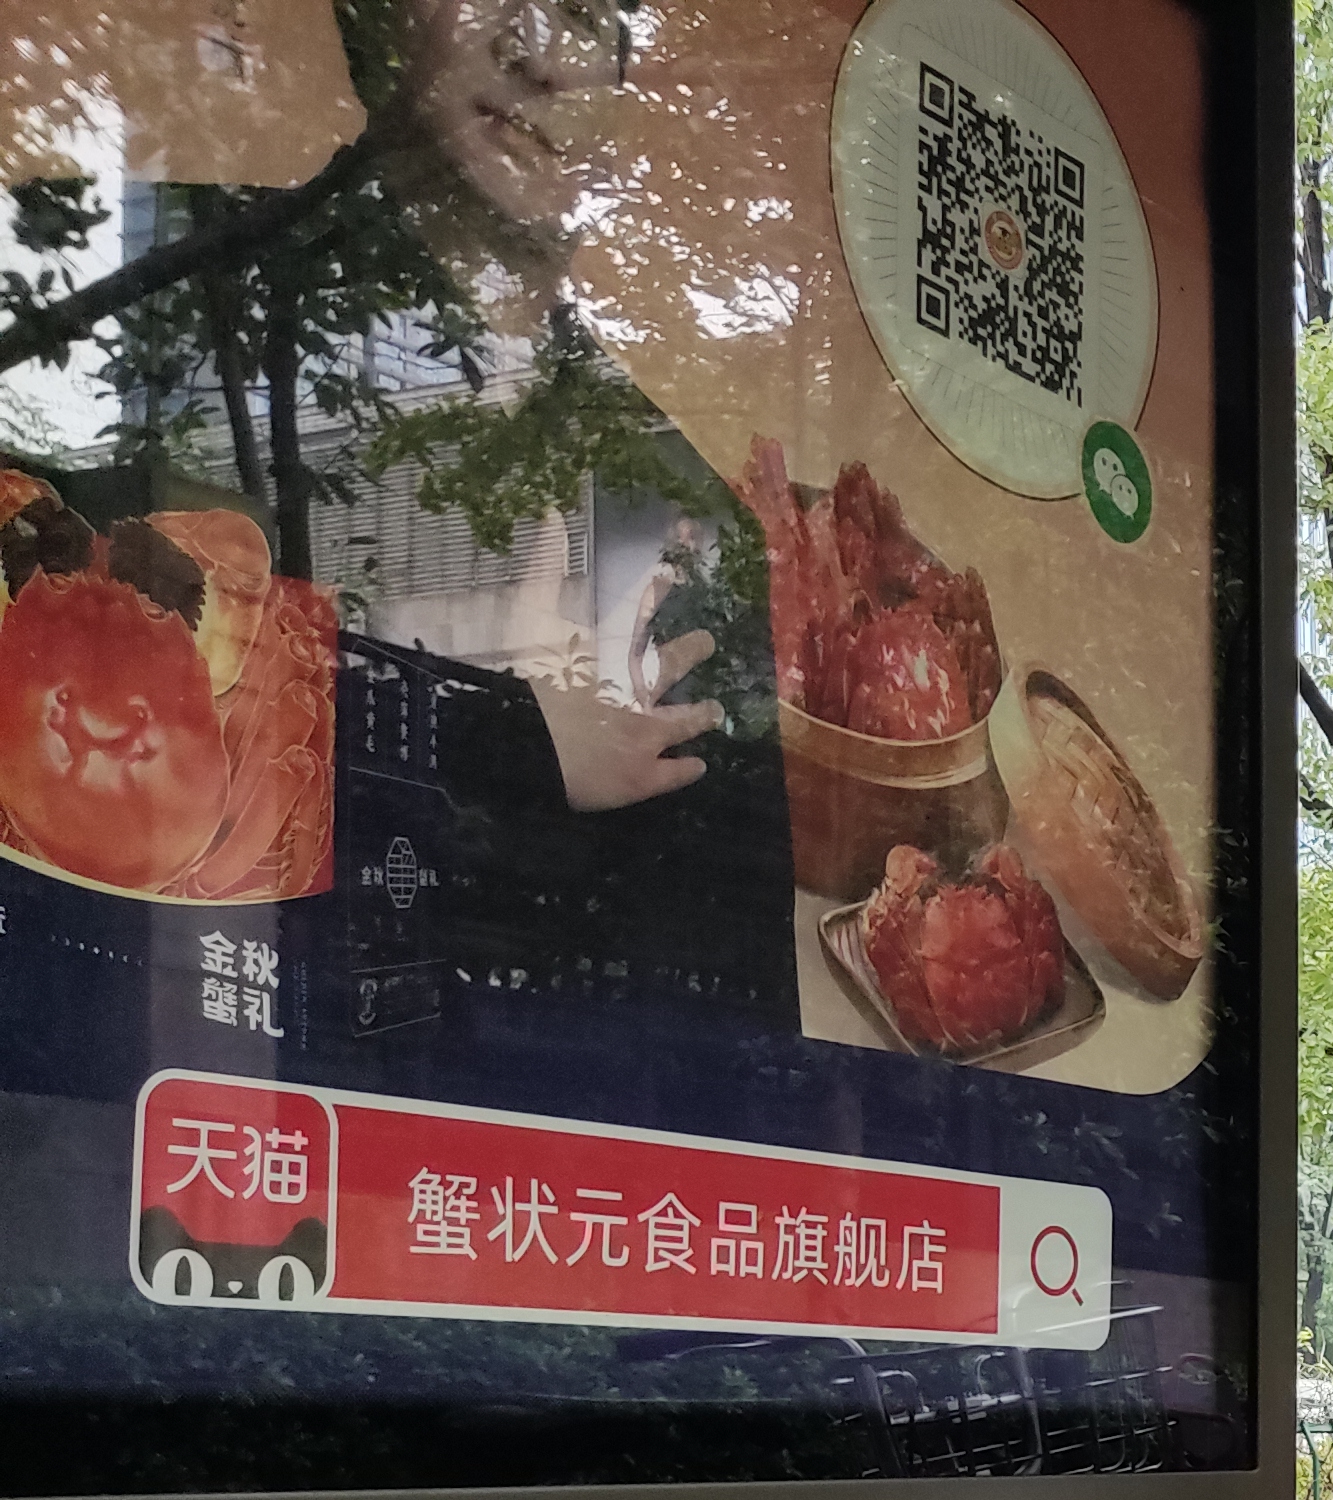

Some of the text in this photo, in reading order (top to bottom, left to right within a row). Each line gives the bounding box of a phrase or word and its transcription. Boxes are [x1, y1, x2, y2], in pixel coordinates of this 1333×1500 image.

[199, 930, 280, 989] 金秋
[201, 977, 285, 1038] 蟹礼
[165, 1115, 311, 1206] 天猫
[406, 1165, 948, 1297] 蟹状元食品旗舰店
